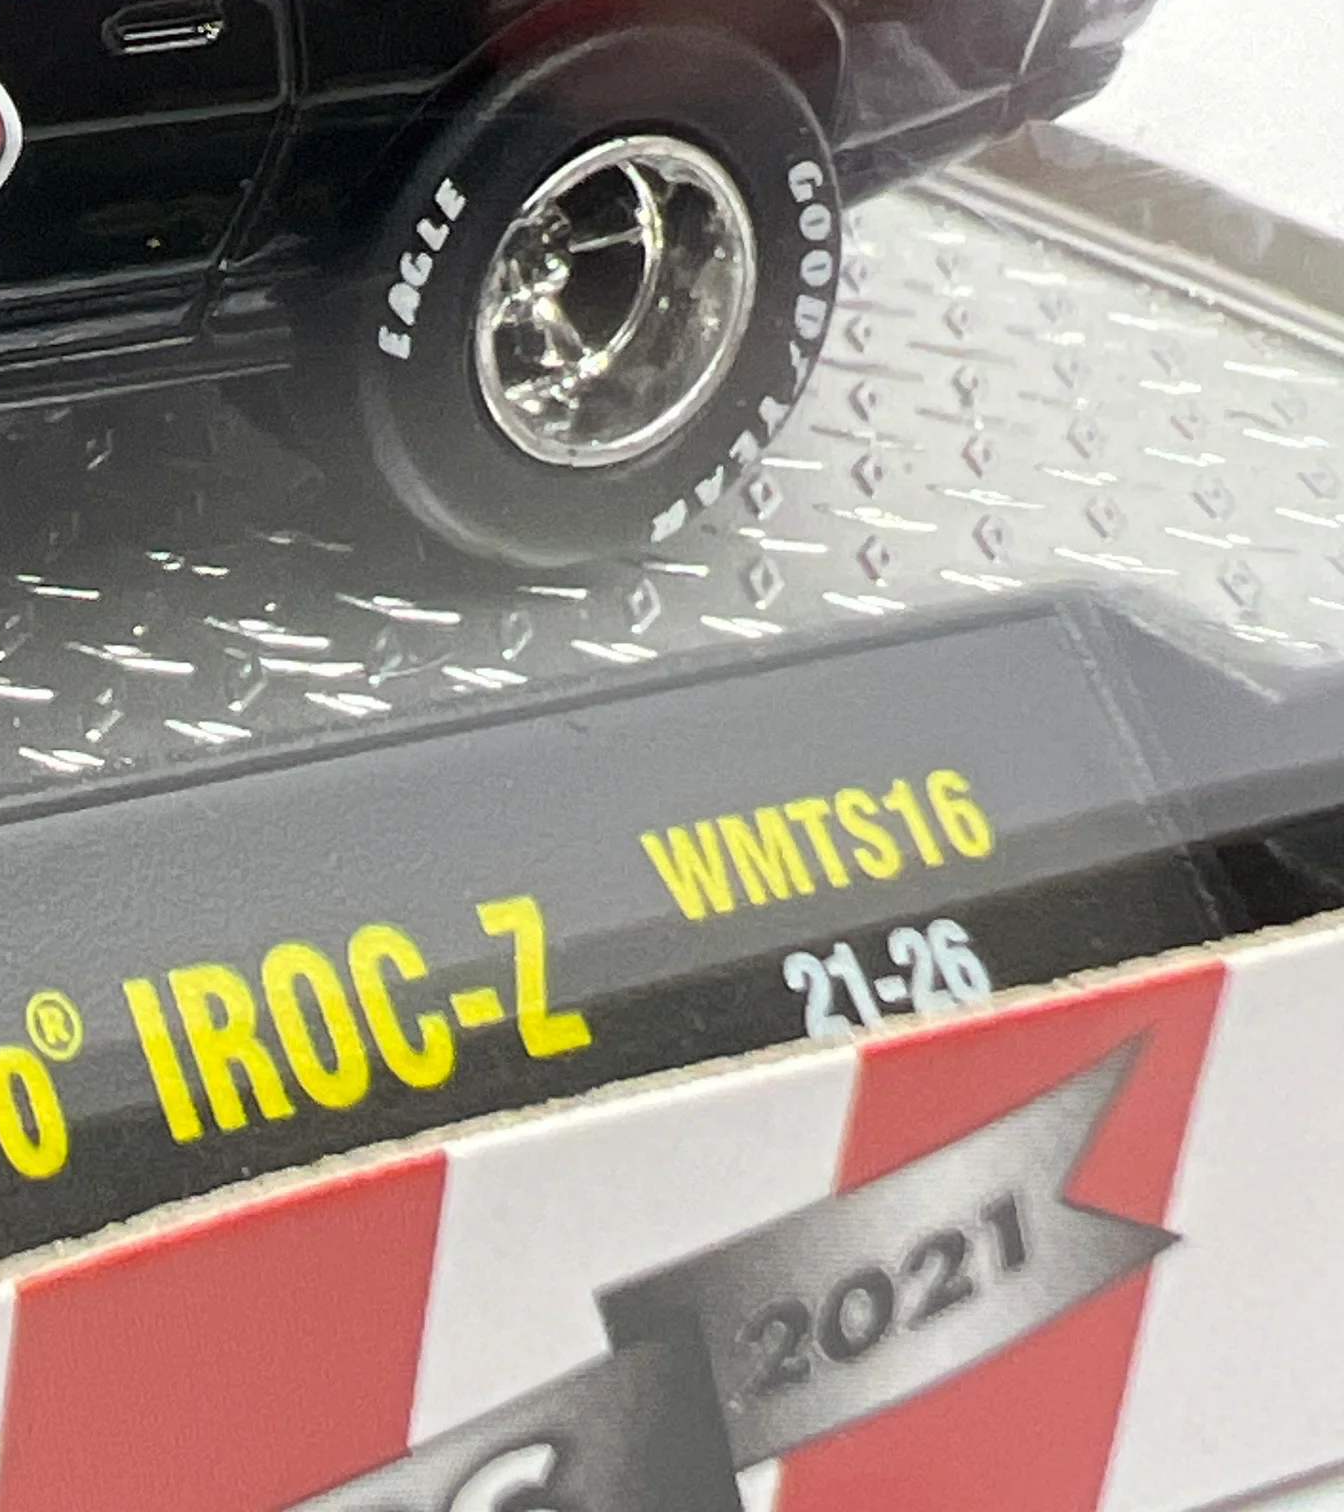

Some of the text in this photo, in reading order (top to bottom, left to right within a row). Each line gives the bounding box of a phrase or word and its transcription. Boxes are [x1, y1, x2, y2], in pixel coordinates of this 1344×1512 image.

[377, 177, 468, 361] EAGLE
[640, 768, 995, 922] WMTS16
[125, 894, 593, 1142] IROC-Z
[782, 918, 994, 1041] 21-26
[744, 1189, 1031, 1394] 2021
